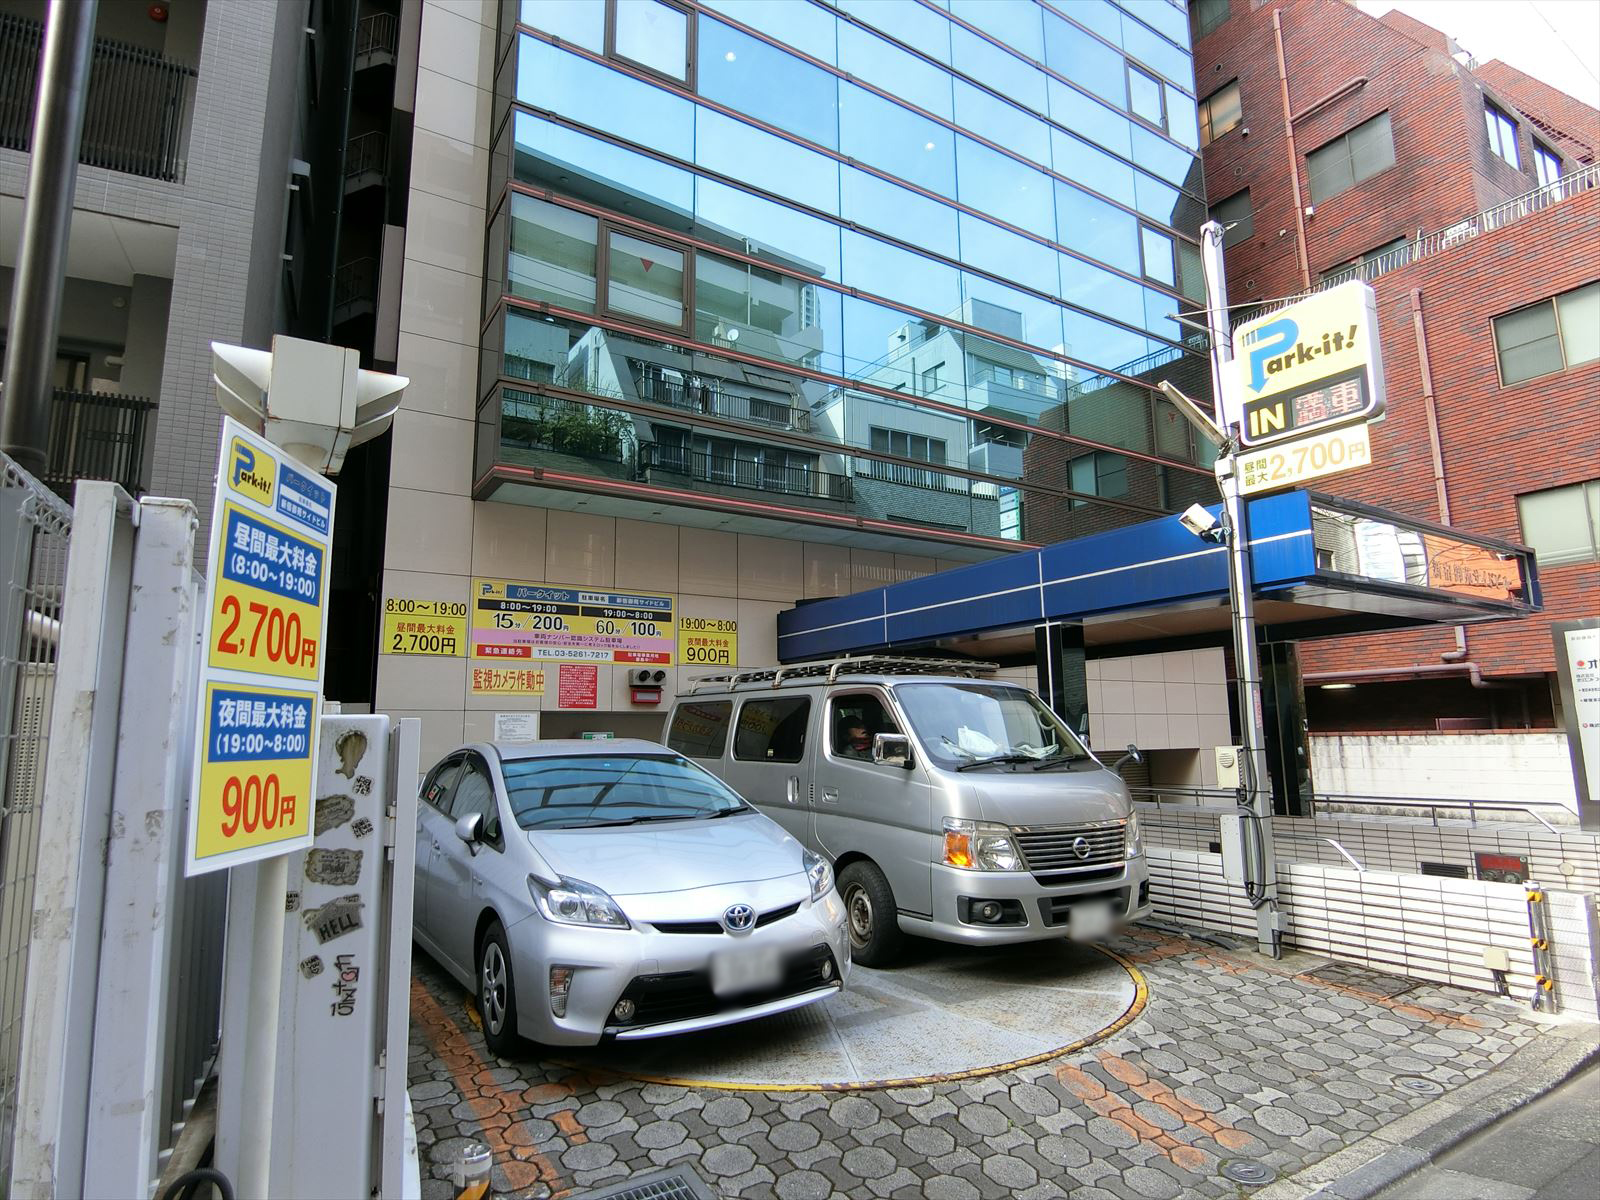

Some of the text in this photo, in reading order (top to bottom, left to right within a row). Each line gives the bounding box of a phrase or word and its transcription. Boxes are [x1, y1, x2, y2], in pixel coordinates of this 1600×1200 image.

[1241, 318, 1358, 394] Park-it!
[1249, 402, 1285, 437] IN
[233, 521, 318, 577] 昼間最大料金
[516, 587, 570, 600] パークイット
[217, 595, 317, 669] 2,700円
[396, 621, 455, 635] 昼間最大料金
[392, 634, 456, 654] 2,700円
[687, 637, 730, 648] 夜間最大料金
[687, 648, 730, 664] 900円
[472, 668, 545, 691] 監視カメラ作動中
[218, 698, 307, 729] 夜間最大料金
[221, 773, 297, 838] 900円
[319, 913, 359, 940] HELL
